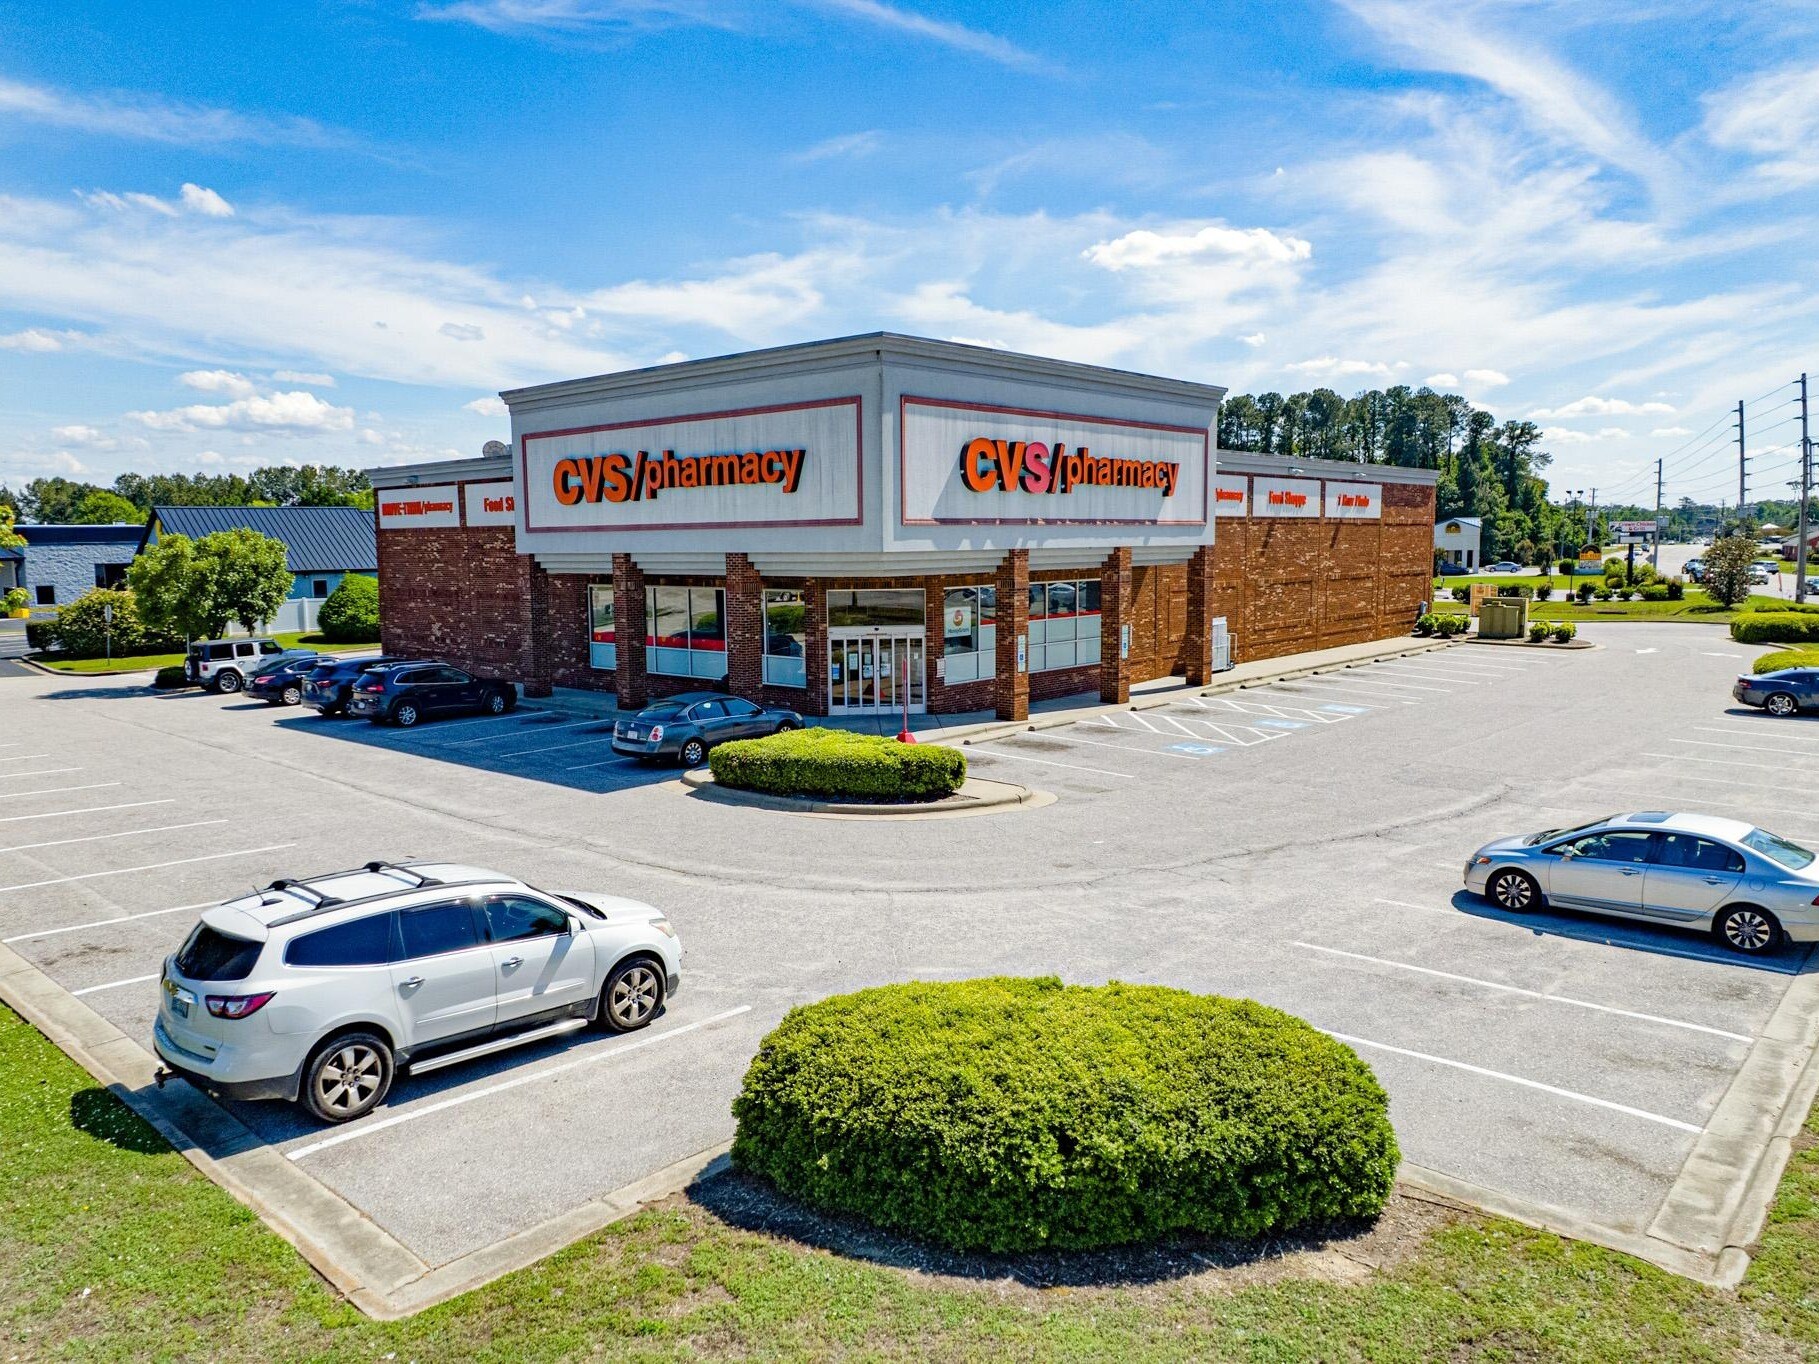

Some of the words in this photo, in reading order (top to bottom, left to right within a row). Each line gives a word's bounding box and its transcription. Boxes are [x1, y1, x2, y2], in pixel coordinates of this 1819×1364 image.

[553, 449, 804, 506] CVS/pharmacy
[961, 437, 1179, 497] CVS/pharmacy
[484, 497, 503, 512] Food
